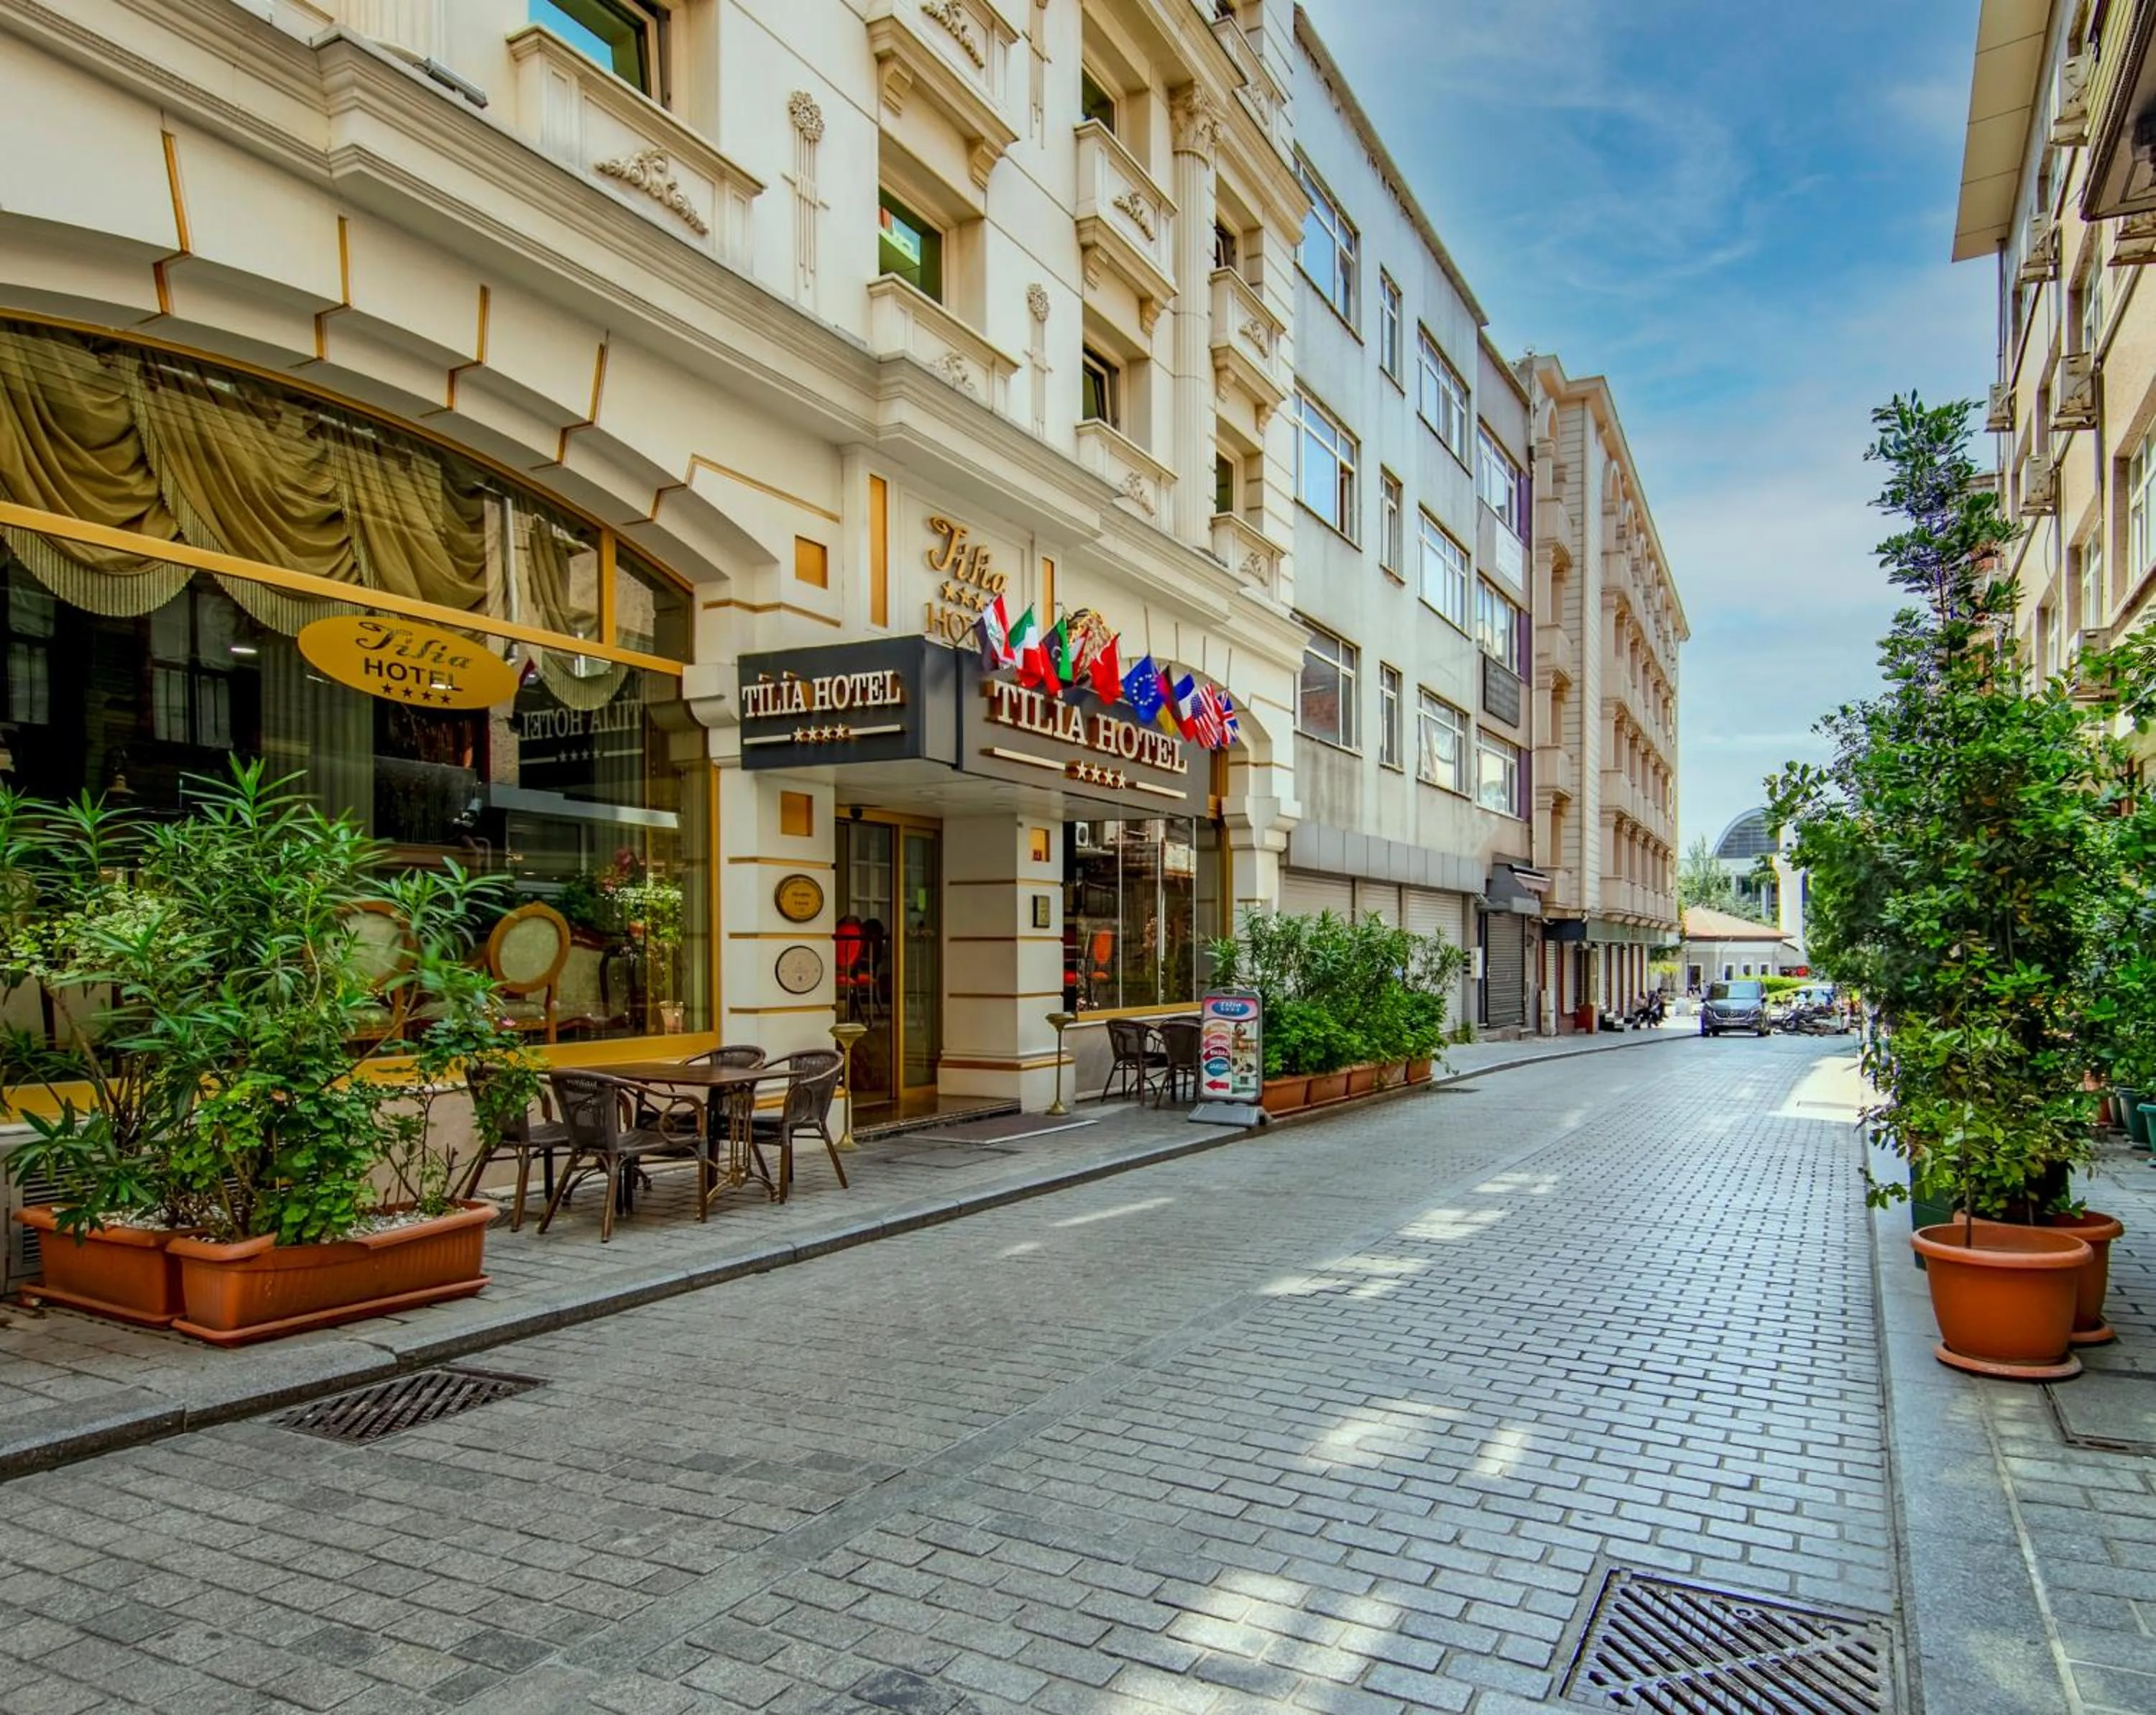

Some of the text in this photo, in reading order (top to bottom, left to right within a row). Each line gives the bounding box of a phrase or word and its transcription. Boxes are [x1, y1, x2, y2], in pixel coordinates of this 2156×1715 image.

[364, 656, 464, 693] HOTEL
[812, 669, 901, 712] HOTEL
[1095, 712, 1188, 775] HOTEL
